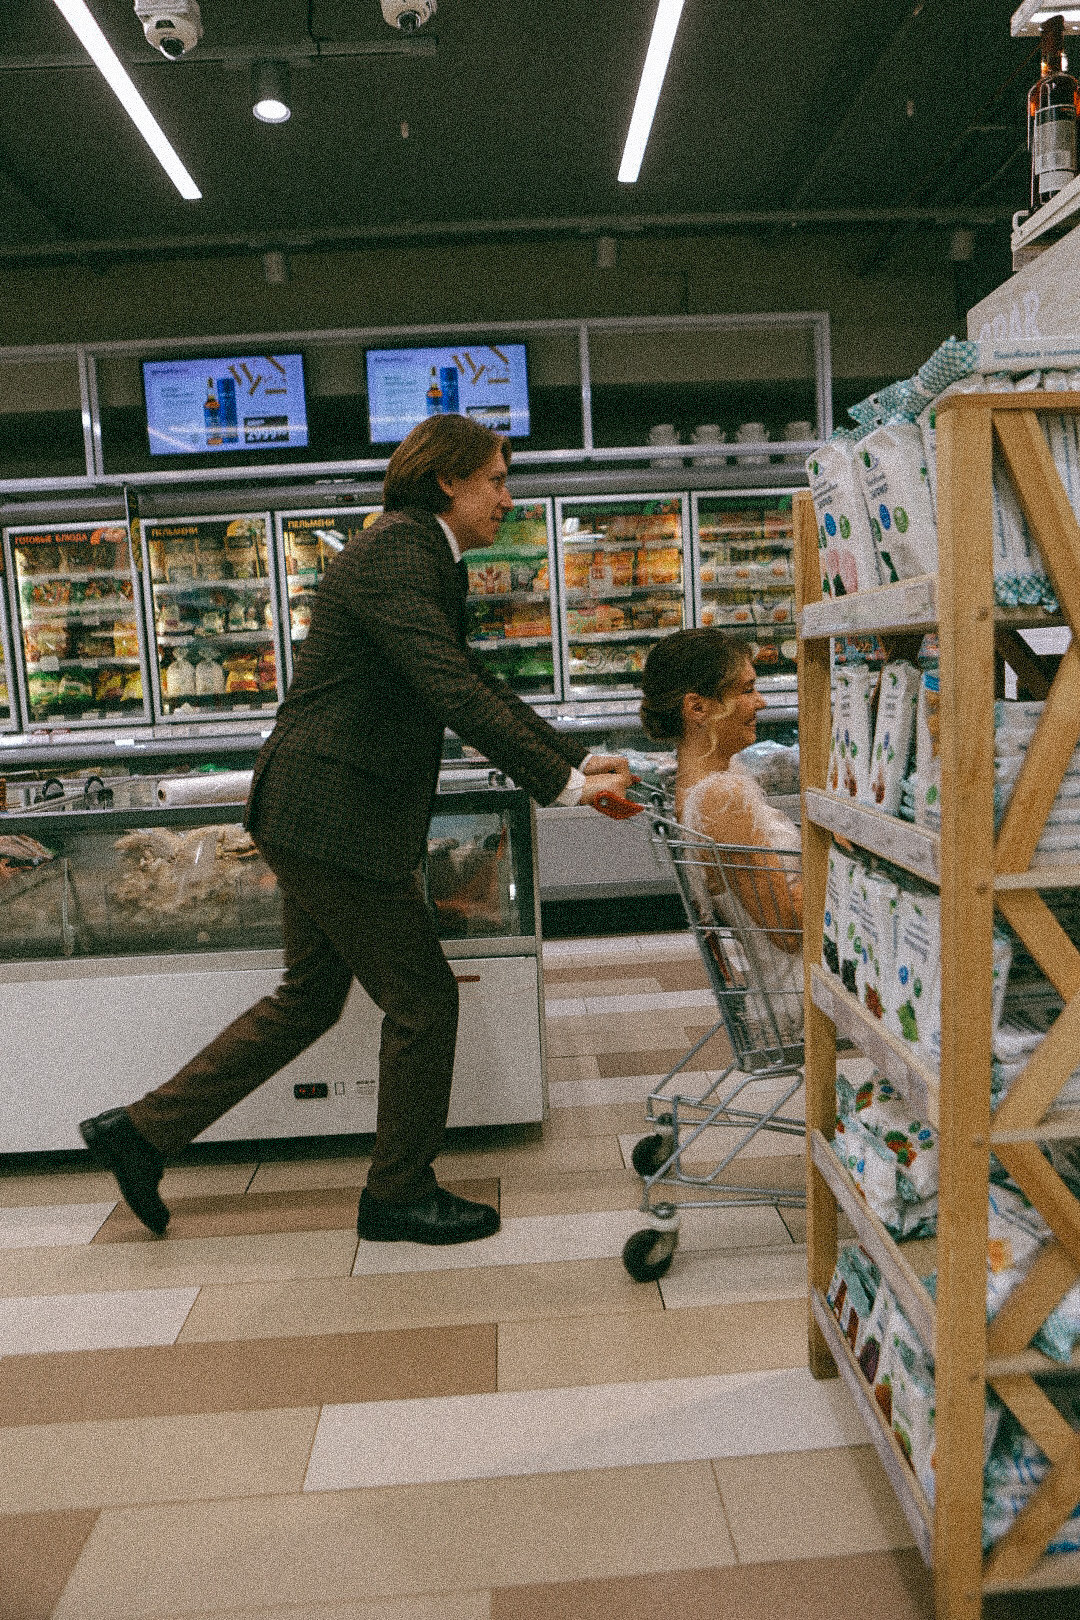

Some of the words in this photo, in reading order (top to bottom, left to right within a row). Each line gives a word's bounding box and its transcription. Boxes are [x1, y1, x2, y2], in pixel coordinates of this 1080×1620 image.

[287, 518, 335, 529] ПЕЛЬМЕНИ
[15, 534, 52, 545] ГОТОВЫЕ
[55, 532, 88, 543] БЛЮДА
